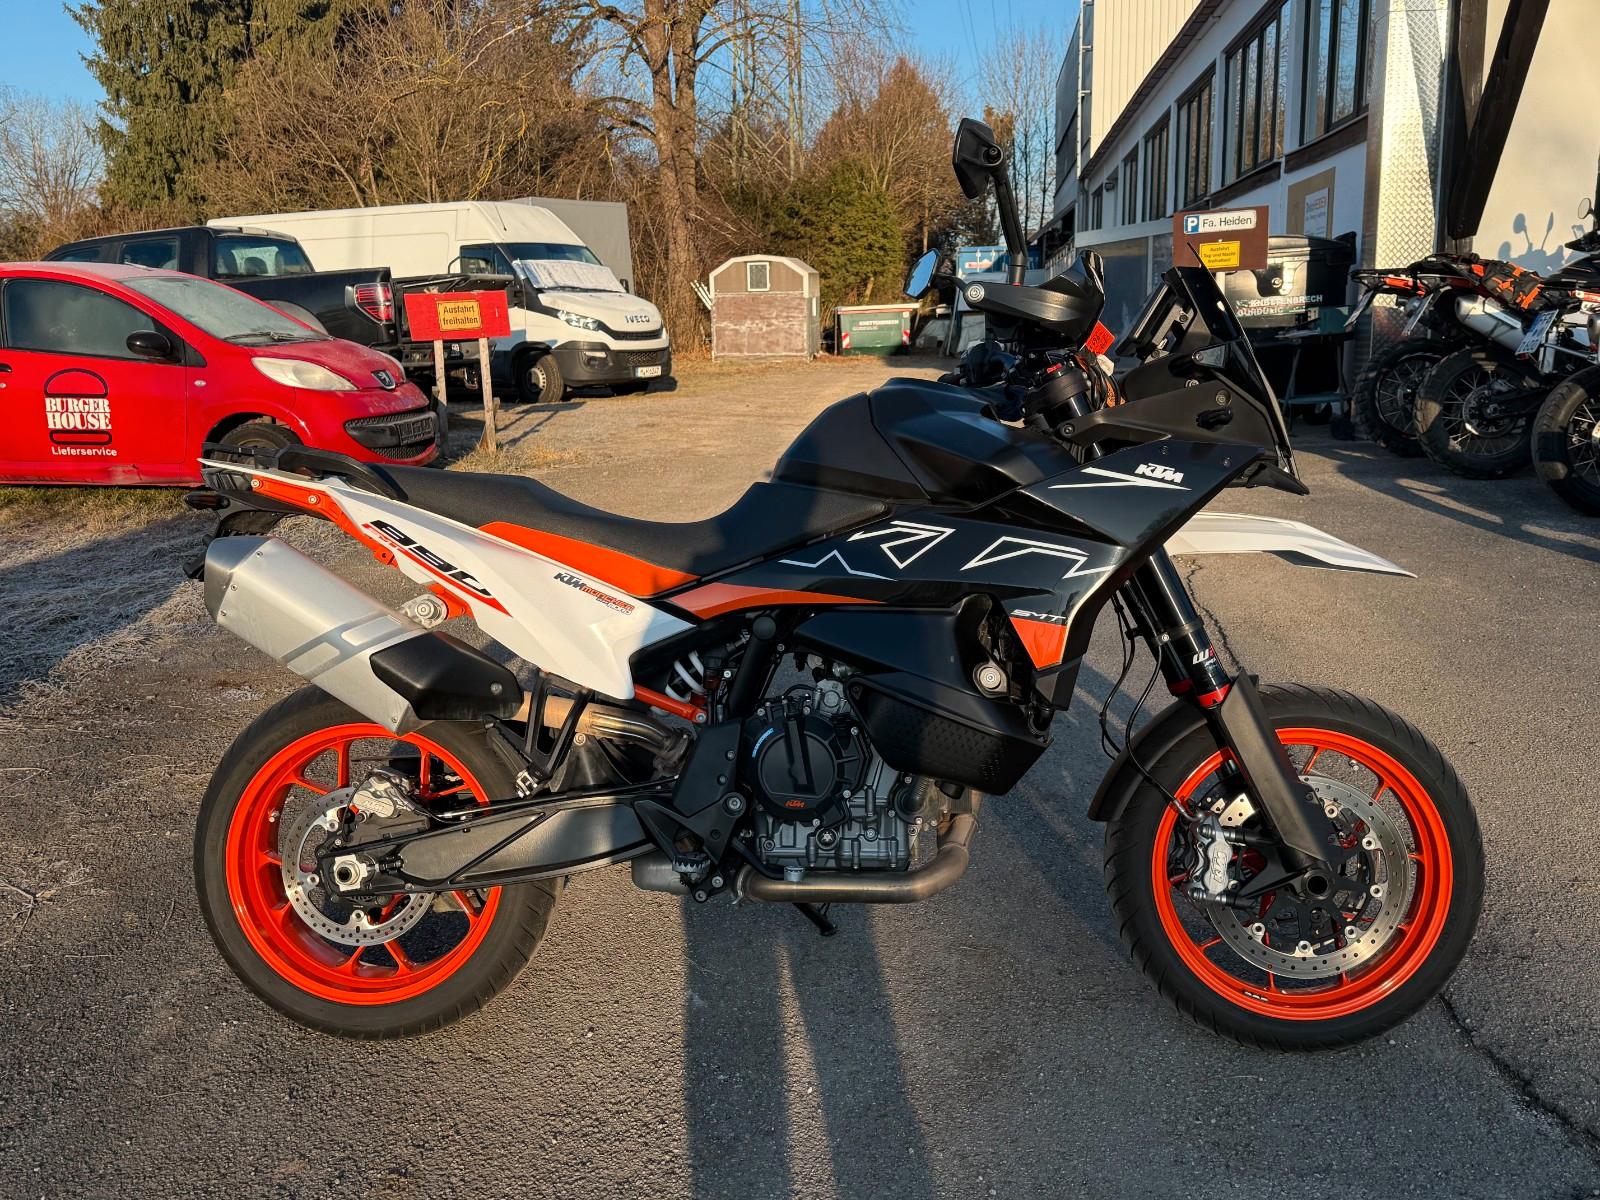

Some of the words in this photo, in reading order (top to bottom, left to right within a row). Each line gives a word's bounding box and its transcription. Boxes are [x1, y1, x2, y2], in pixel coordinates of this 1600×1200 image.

[1202, 218, 1217, 228] Fa.
[1219, 216, 1252, 227] Heiden
[443, 304, 475, 314] Ausfahrt
[442, 316, 479, 326] freihalten
[625, 315, 650, 323] IVECO
[44, 398, 111, 413] BURGER
[46, 411, 113, 430] HOUSE
[51, 446, 118, 457] Lieferservice
[1134, 462, 1185, 484] KTM
[369, 519, 493, 597] 890
[553, 572, 588, 590] KTM
[1010, 608, 1067, 622] SMT
